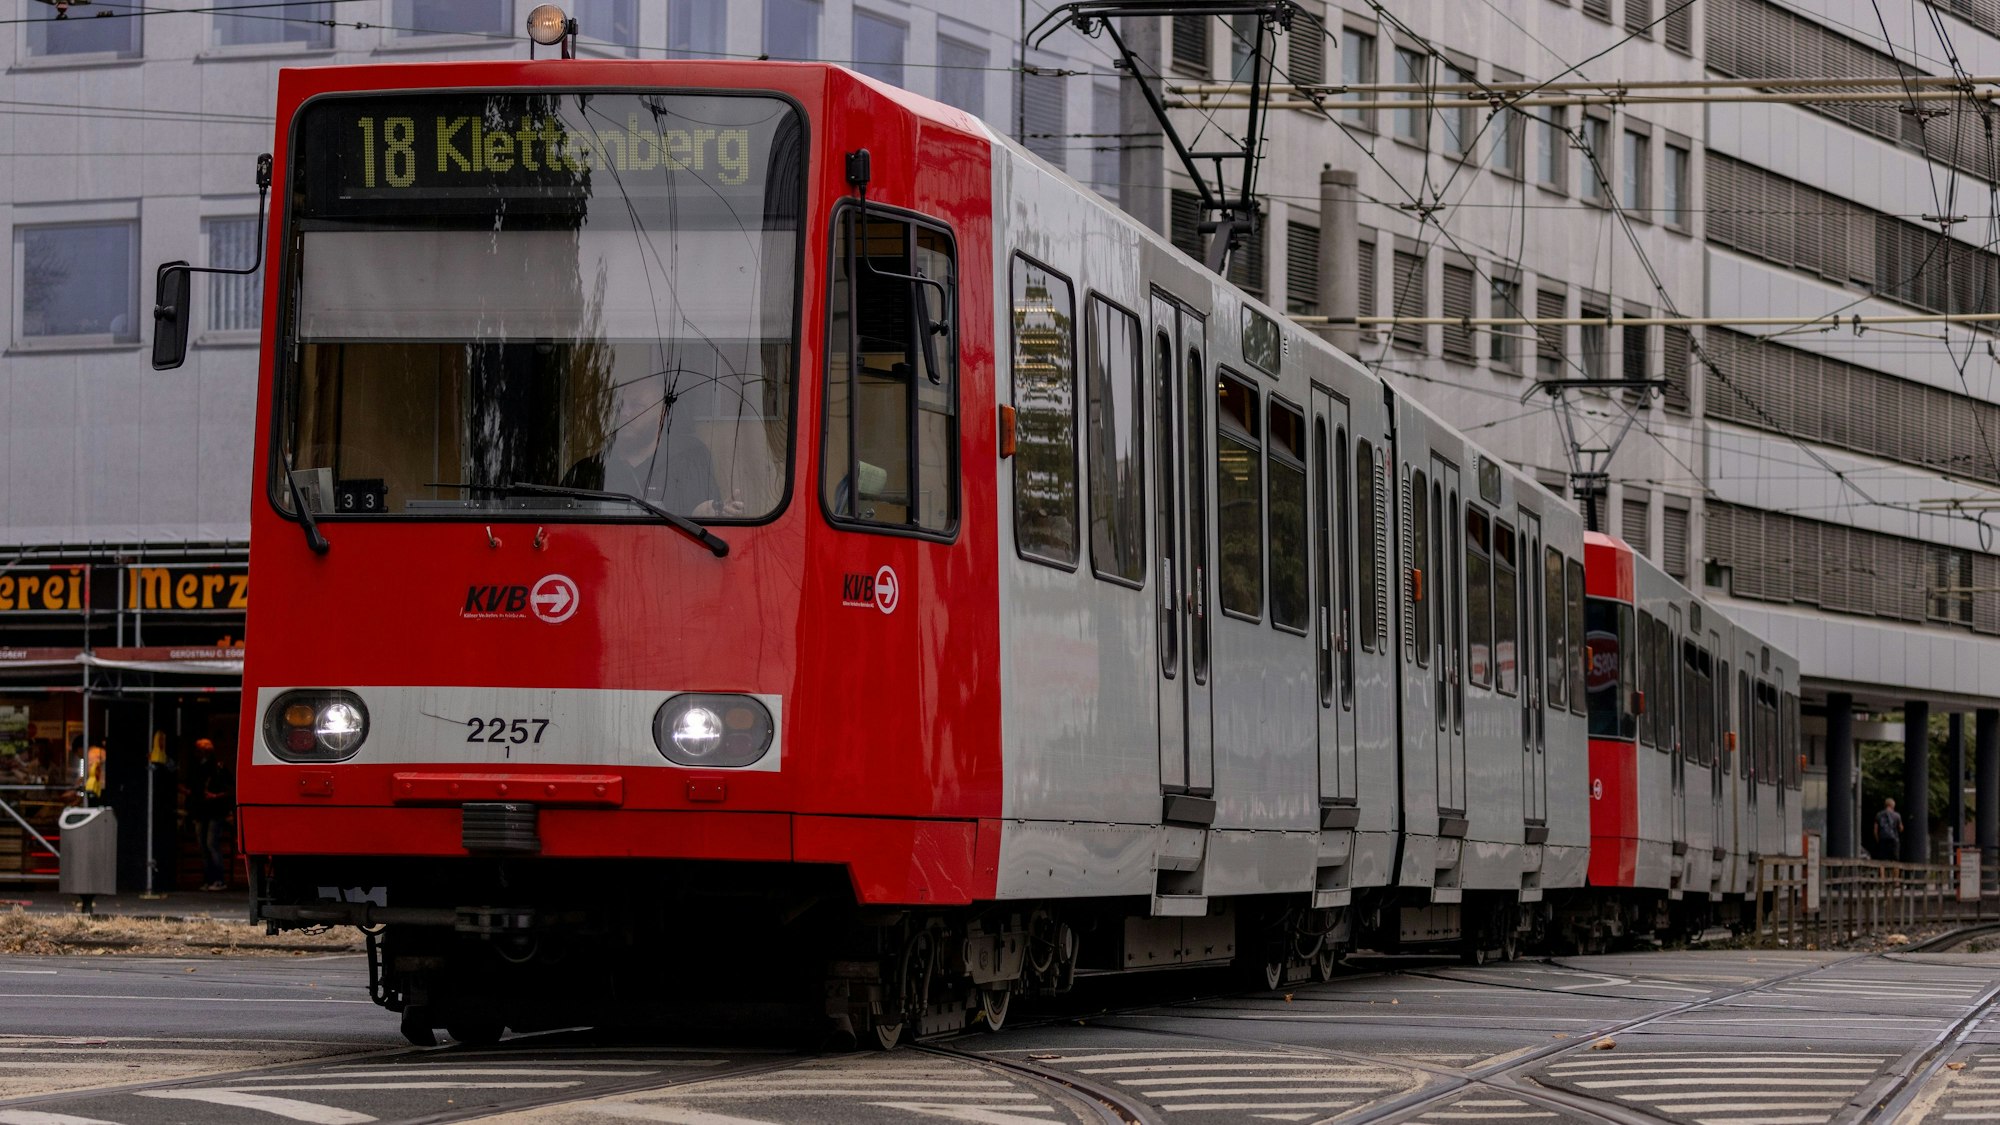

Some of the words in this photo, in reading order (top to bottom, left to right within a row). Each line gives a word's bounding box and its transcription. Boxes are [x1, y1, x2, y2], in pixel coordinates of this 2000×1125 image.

[357, 116, 417, 189] 18
[436, 112, 749, 186] Klettenberg
[465, 586, 528, 611] KVB
[843, 573, 874, 601] KVB
[467, 718, 550, 744] 2257
[504, 746, 511, 759] 1
